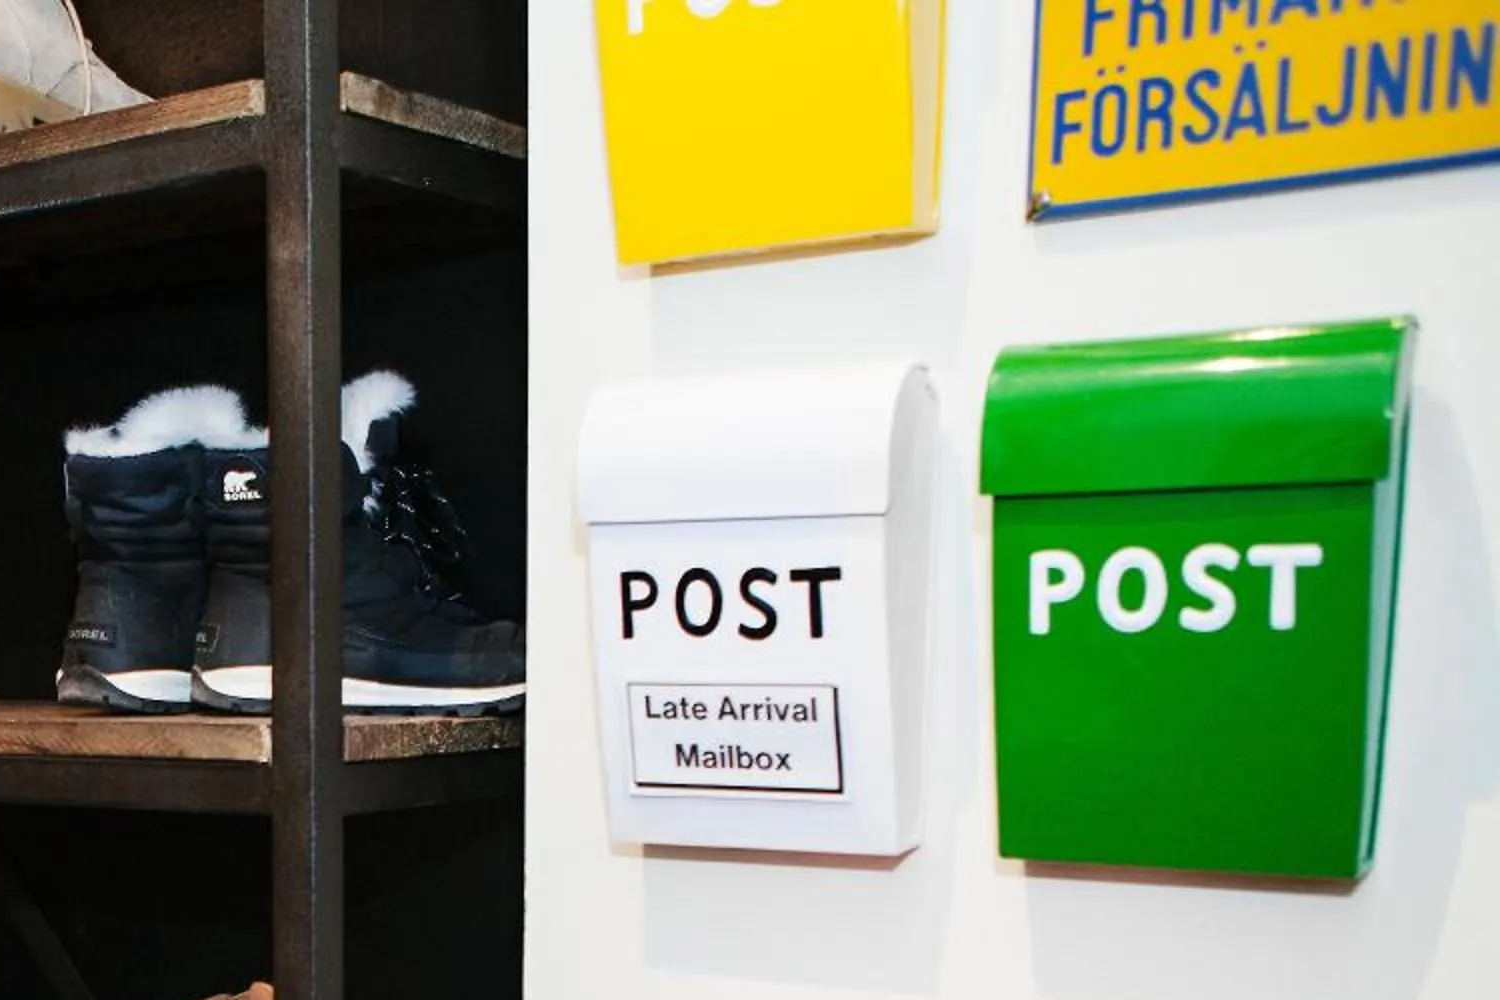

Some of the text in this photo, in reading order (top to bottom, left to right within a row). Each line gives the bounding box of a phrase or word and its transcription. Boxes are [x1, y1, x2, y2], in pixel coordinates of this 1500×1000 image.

[223, 490, 262, 501] SOREL
[620, 566, 842, 640] POST
[1028, 542, 1324, 636] POST
[645, 695, 818, 723] Late Arrival
[675, 743, 792, 771] Mailbox
